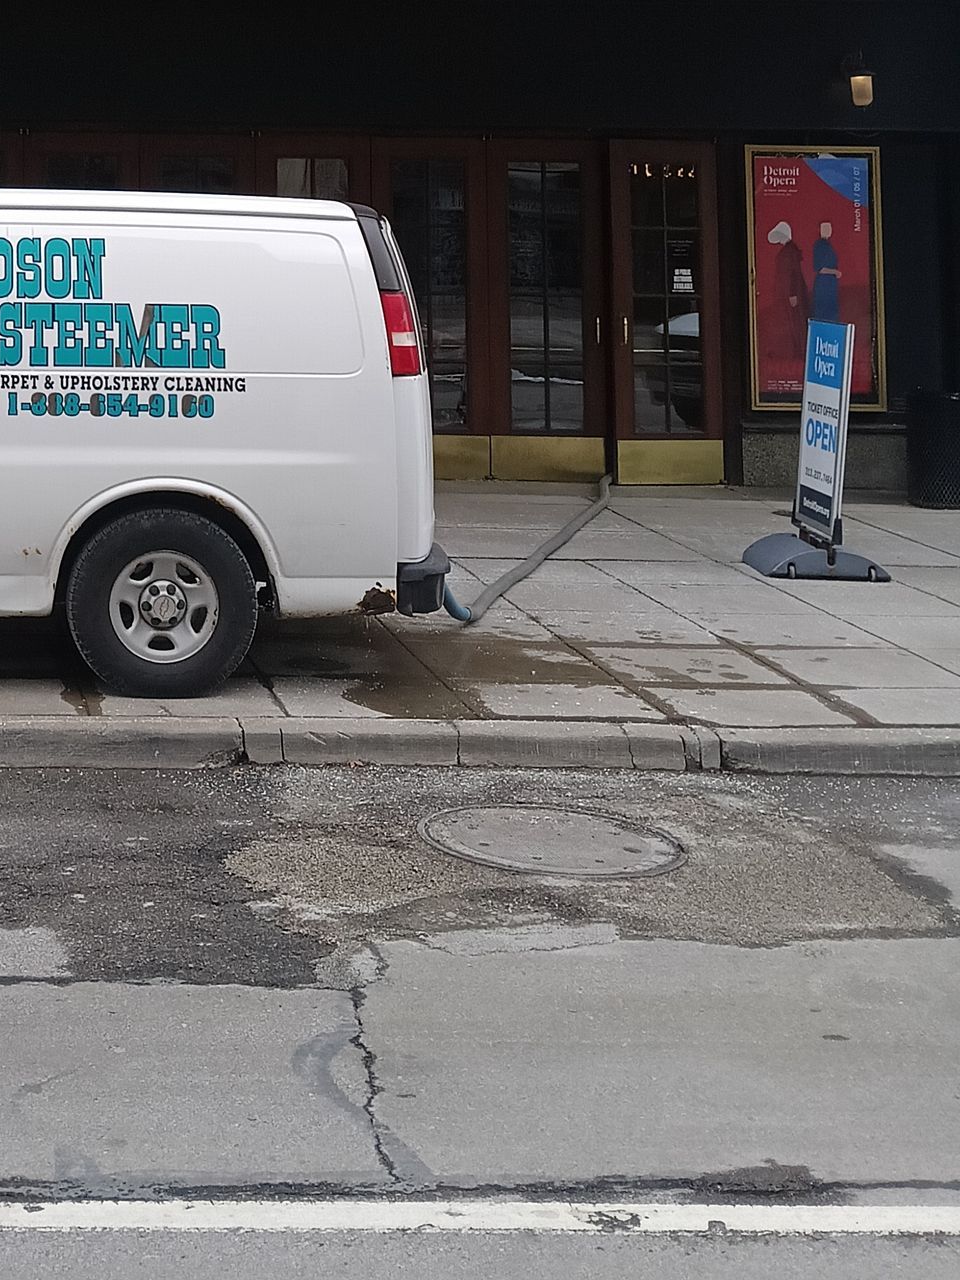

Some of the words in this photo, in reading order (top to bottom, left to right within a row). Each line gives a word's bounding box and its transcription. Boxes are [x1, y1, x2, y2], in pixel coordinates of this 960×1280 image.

[763, 165, 799, 176] Detroit
[763, 176, 796, 187] Opera
[854, 199, 860, 208] 01
[815, 336, 839, 359] Detroit
[814, 356, 835, 378] Opera
[44, 375, 55, 391] &
[60, 375, 159, 392] UPHOLSTERY
[164, 376, 246, 393] CLEANING
[807, 401, 823, 416] TICKET
[823, 404, 839, 419] OFFICE
[805, 418, 837, 453] OPEN
